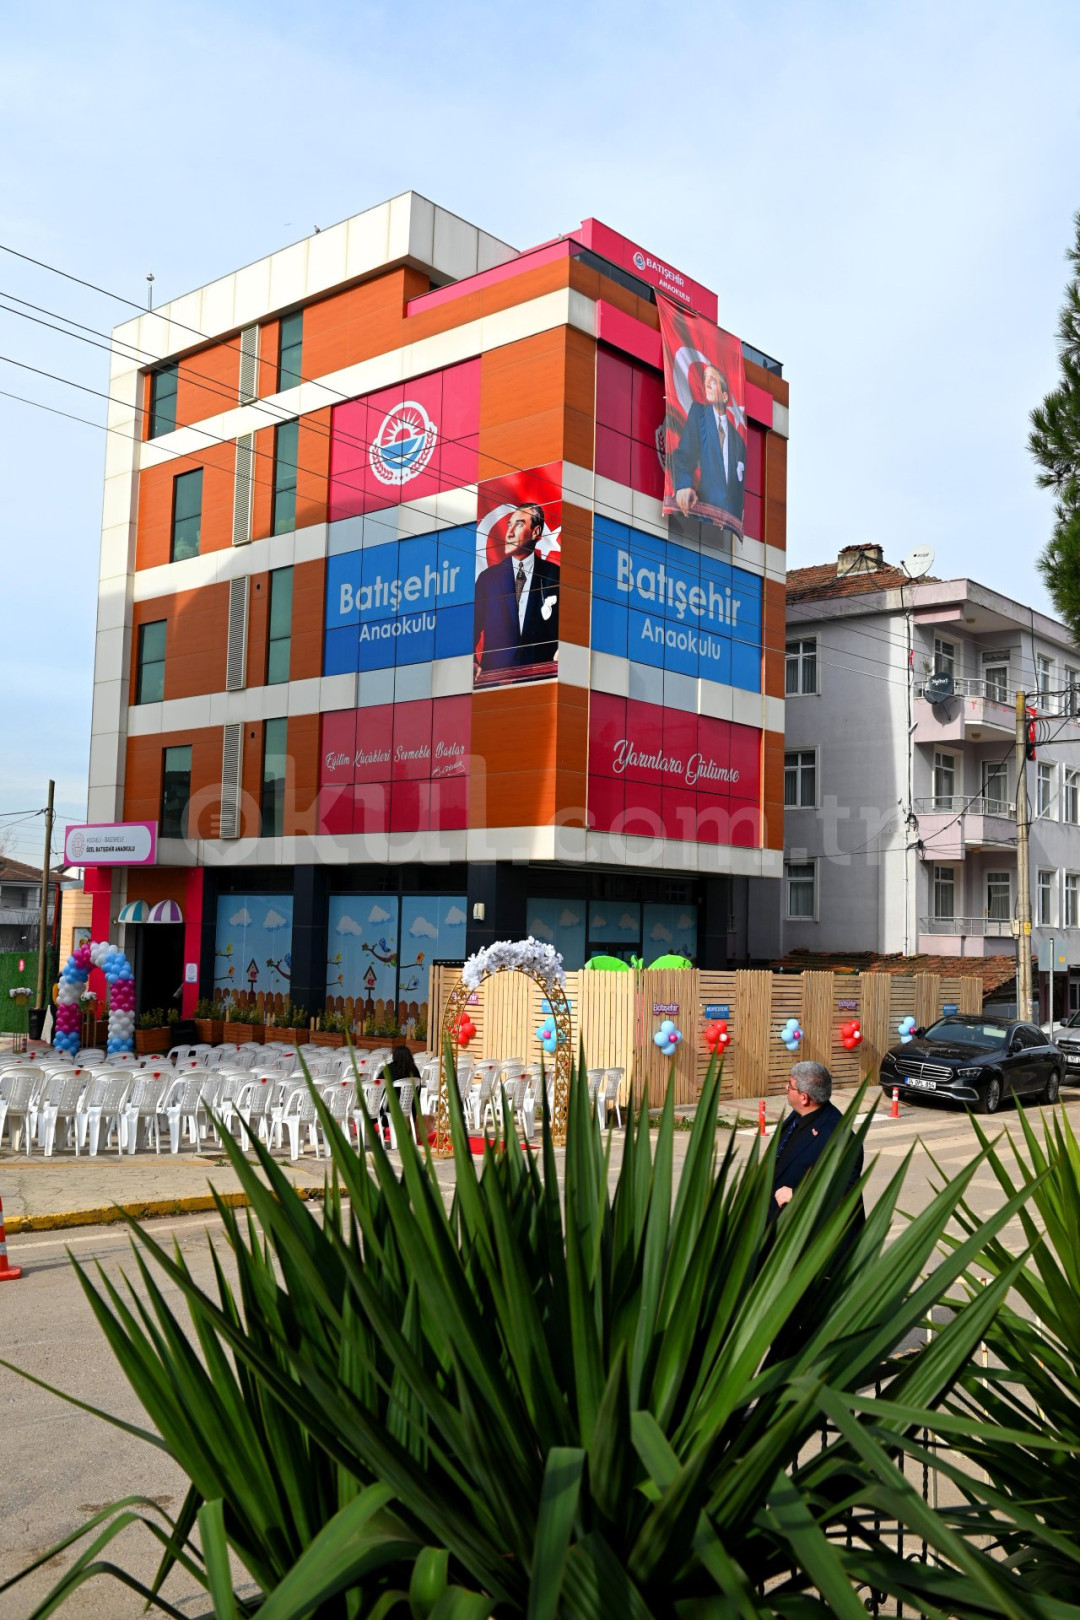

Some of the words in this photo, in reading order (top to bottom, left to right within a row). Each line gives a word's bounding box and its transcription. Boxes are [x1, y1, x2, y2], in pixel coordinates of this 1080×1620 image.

[646, 258, 684, 287] BATIŞEHİR
[659, 279, 690, 302] ANAOKULU
[339, 560, 461, 616] Batışehir
[617, 549, 741, 627] Batışehir
[359, 612, 437, 643] Anaokulu
[641, 618, 721, 661] Anaokulu
[325, 751, 350, 771] Eğitim
[352, 749, 391, 768] Küçükleri
[612, 739, 684, 775] Yarınlara
[685, 752, 740, 785] Gülümse
